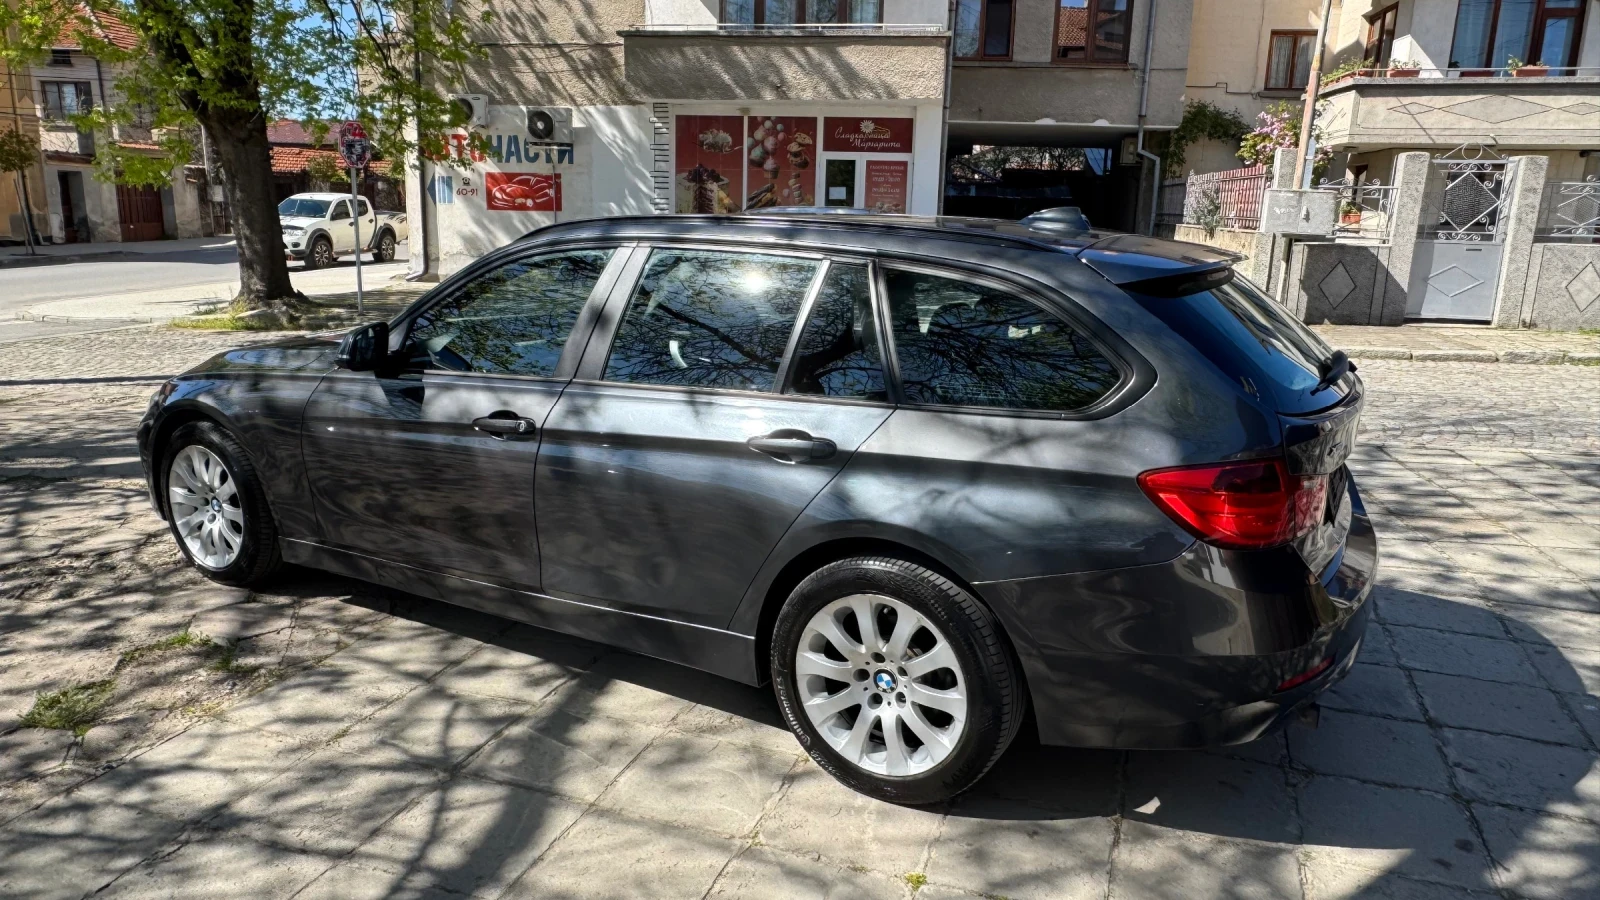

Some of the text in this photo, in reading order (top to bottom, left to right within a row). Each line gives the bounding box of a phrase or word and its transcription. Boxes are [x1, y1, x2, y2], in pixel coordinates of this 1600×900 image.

[426, 134, 574, 164] ТОЧАСИ
[851, 139, 901, 151] Маргарита
[456, 188, 478, 196] 60-91
